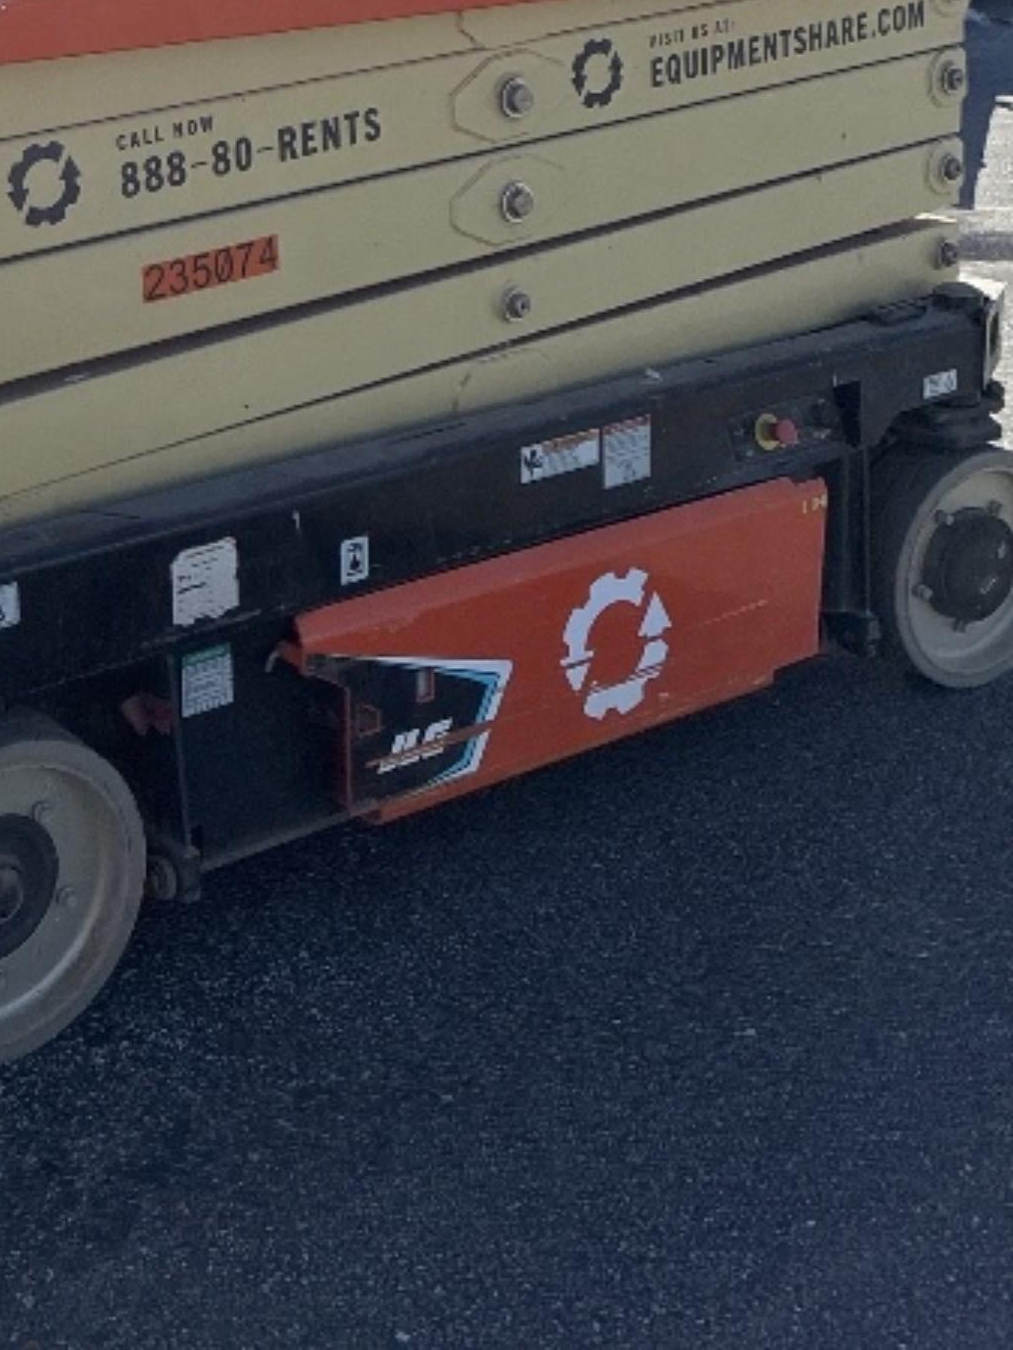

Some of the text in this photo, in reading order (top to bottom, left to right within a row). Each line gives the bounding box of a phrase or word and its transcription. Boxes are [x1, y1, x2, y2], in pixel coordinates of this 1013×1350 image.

[648, 27, 685, 49] VISIT
[649, 0, 926, 88] EQUIPMENTSHARE.COM
[115, 115, 214, 151] CALL NOW
[120, 107, 382, 199] 888-80-RENTS
[142, 235, 277, 302] 235074
